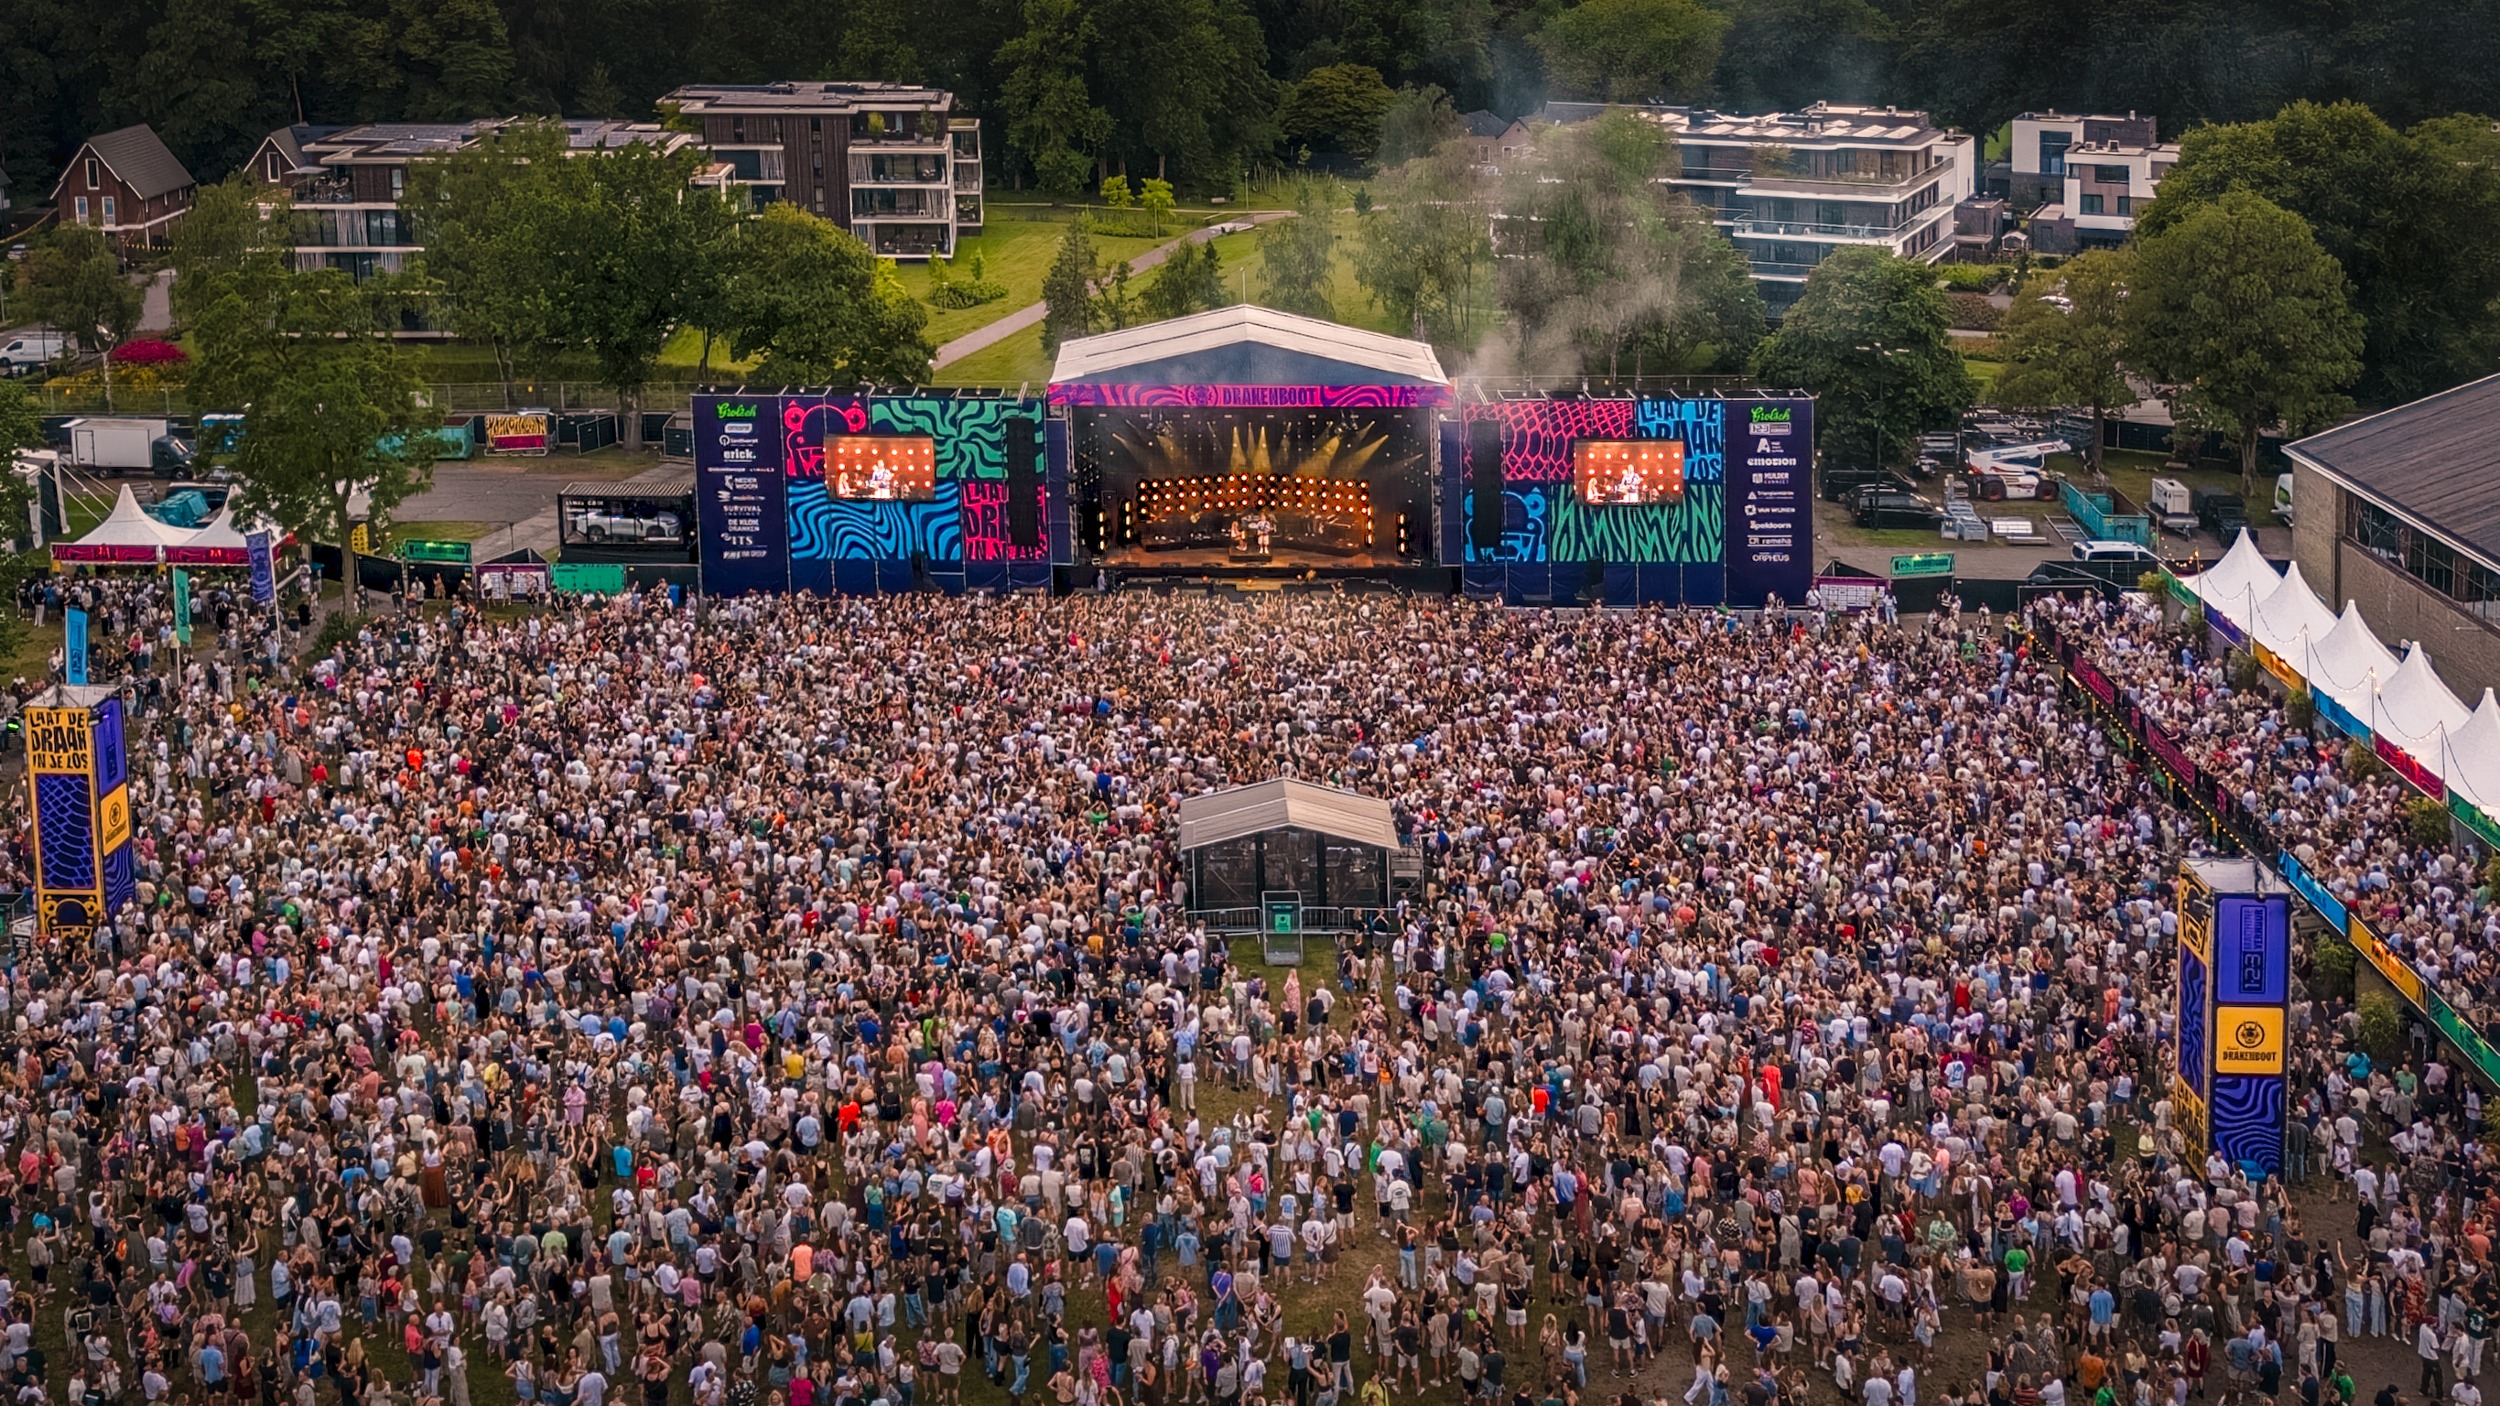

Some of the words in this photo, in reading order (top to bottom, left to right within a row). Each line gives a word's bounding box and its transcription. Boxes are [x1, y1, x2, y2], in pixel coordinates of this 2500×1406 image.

[1223, 387, 1317, 405] DRAKENBOOT
[717, 402, 757, 419] Grolsch
[1695, 401, 1719, 422] DE
[1751, 406, 1791, 422] Grolsch
[30, 712, 61, 727] LAAT
[67, 712, 85, 728] DE
[33, 753, 46, 768] IN
[50, 754, 63, 768] JE
[67, 753, 88, 769] LOS
[2223, 1051, 2277, 1061] DRAKENBOOT
